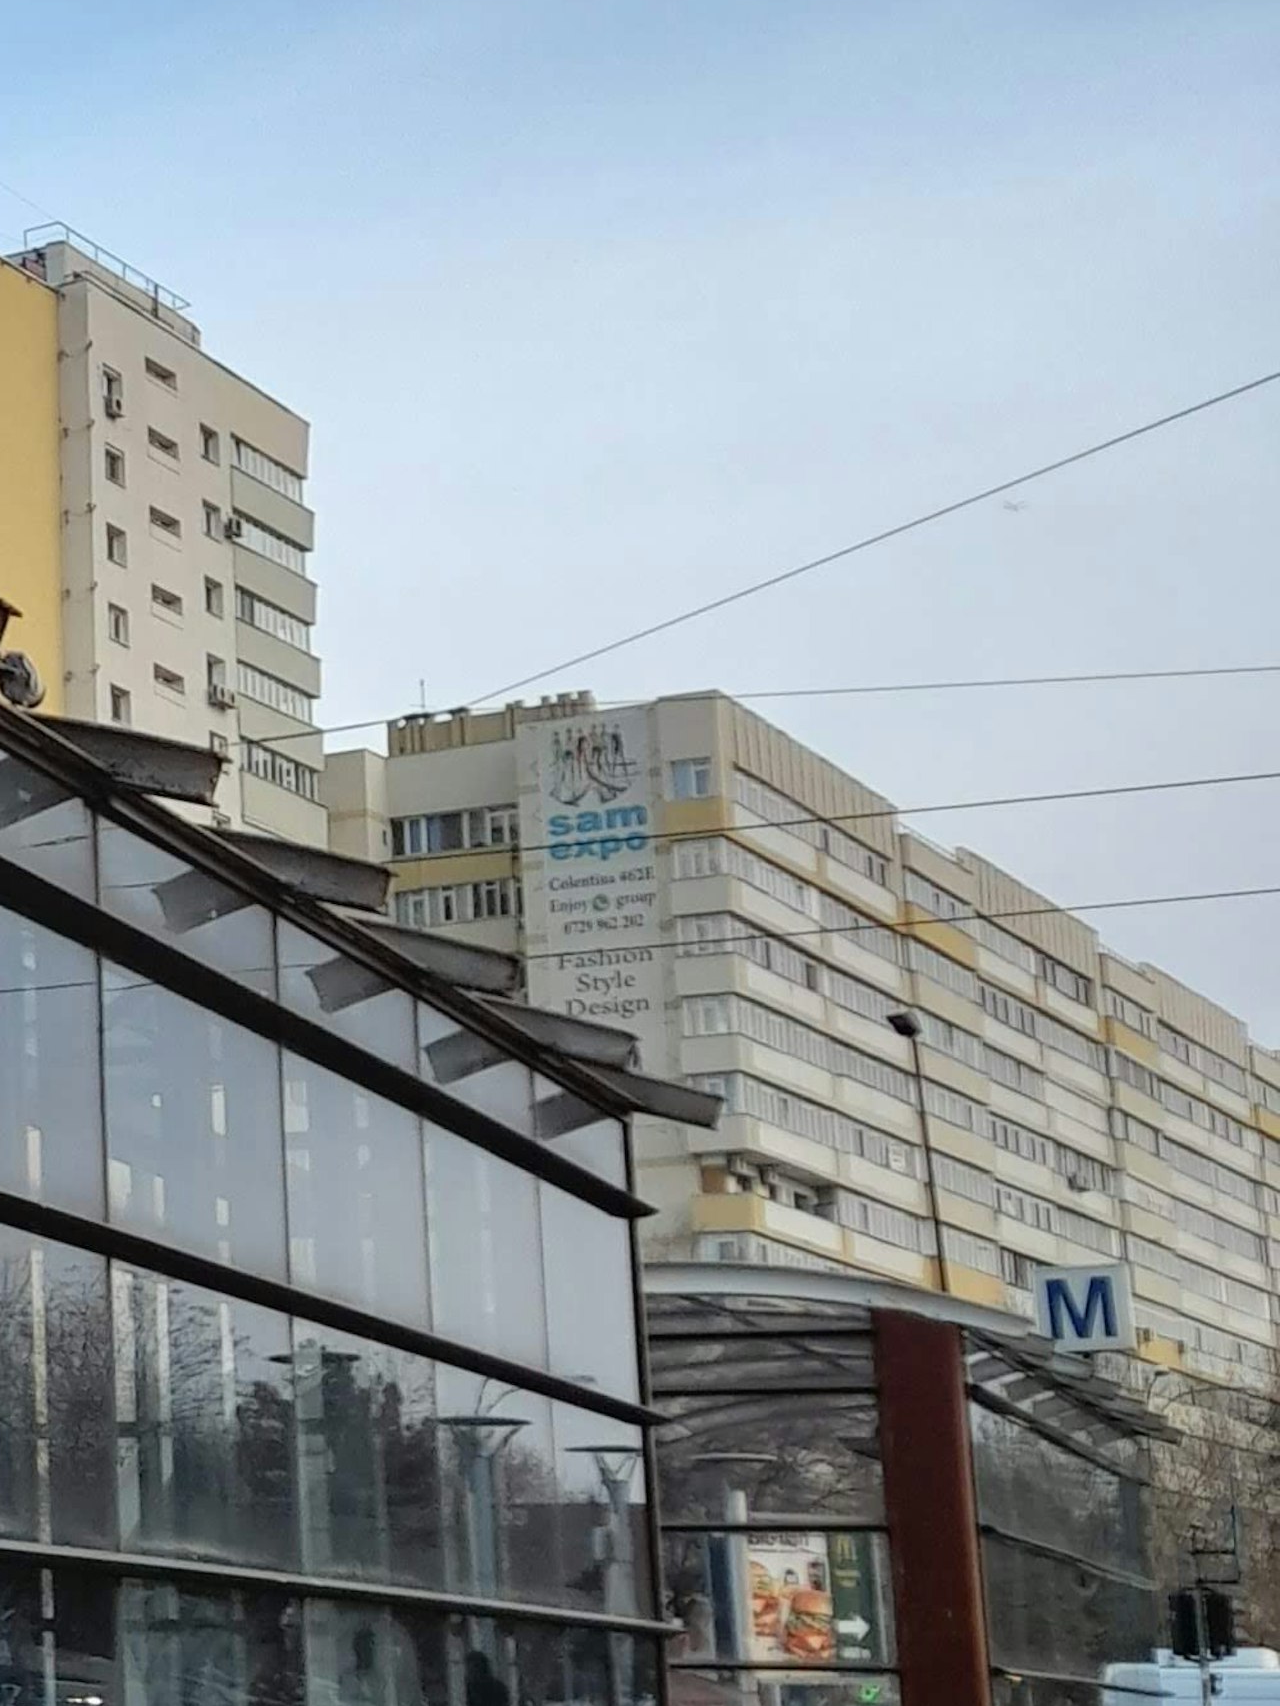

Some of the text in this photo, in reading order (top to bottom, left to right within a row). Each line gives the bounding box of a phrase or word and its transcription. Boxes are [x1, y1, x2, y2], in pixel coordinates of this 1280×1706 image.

[548, 805, 648, 836] sam
[549, 833, 648, 861] expo
[558, 948, 654, 971] Fashion
[576, 970, 637, 996] Style
[565, 996, 650, 1019] Design
[1045, 1275, 1119, 1340] M
